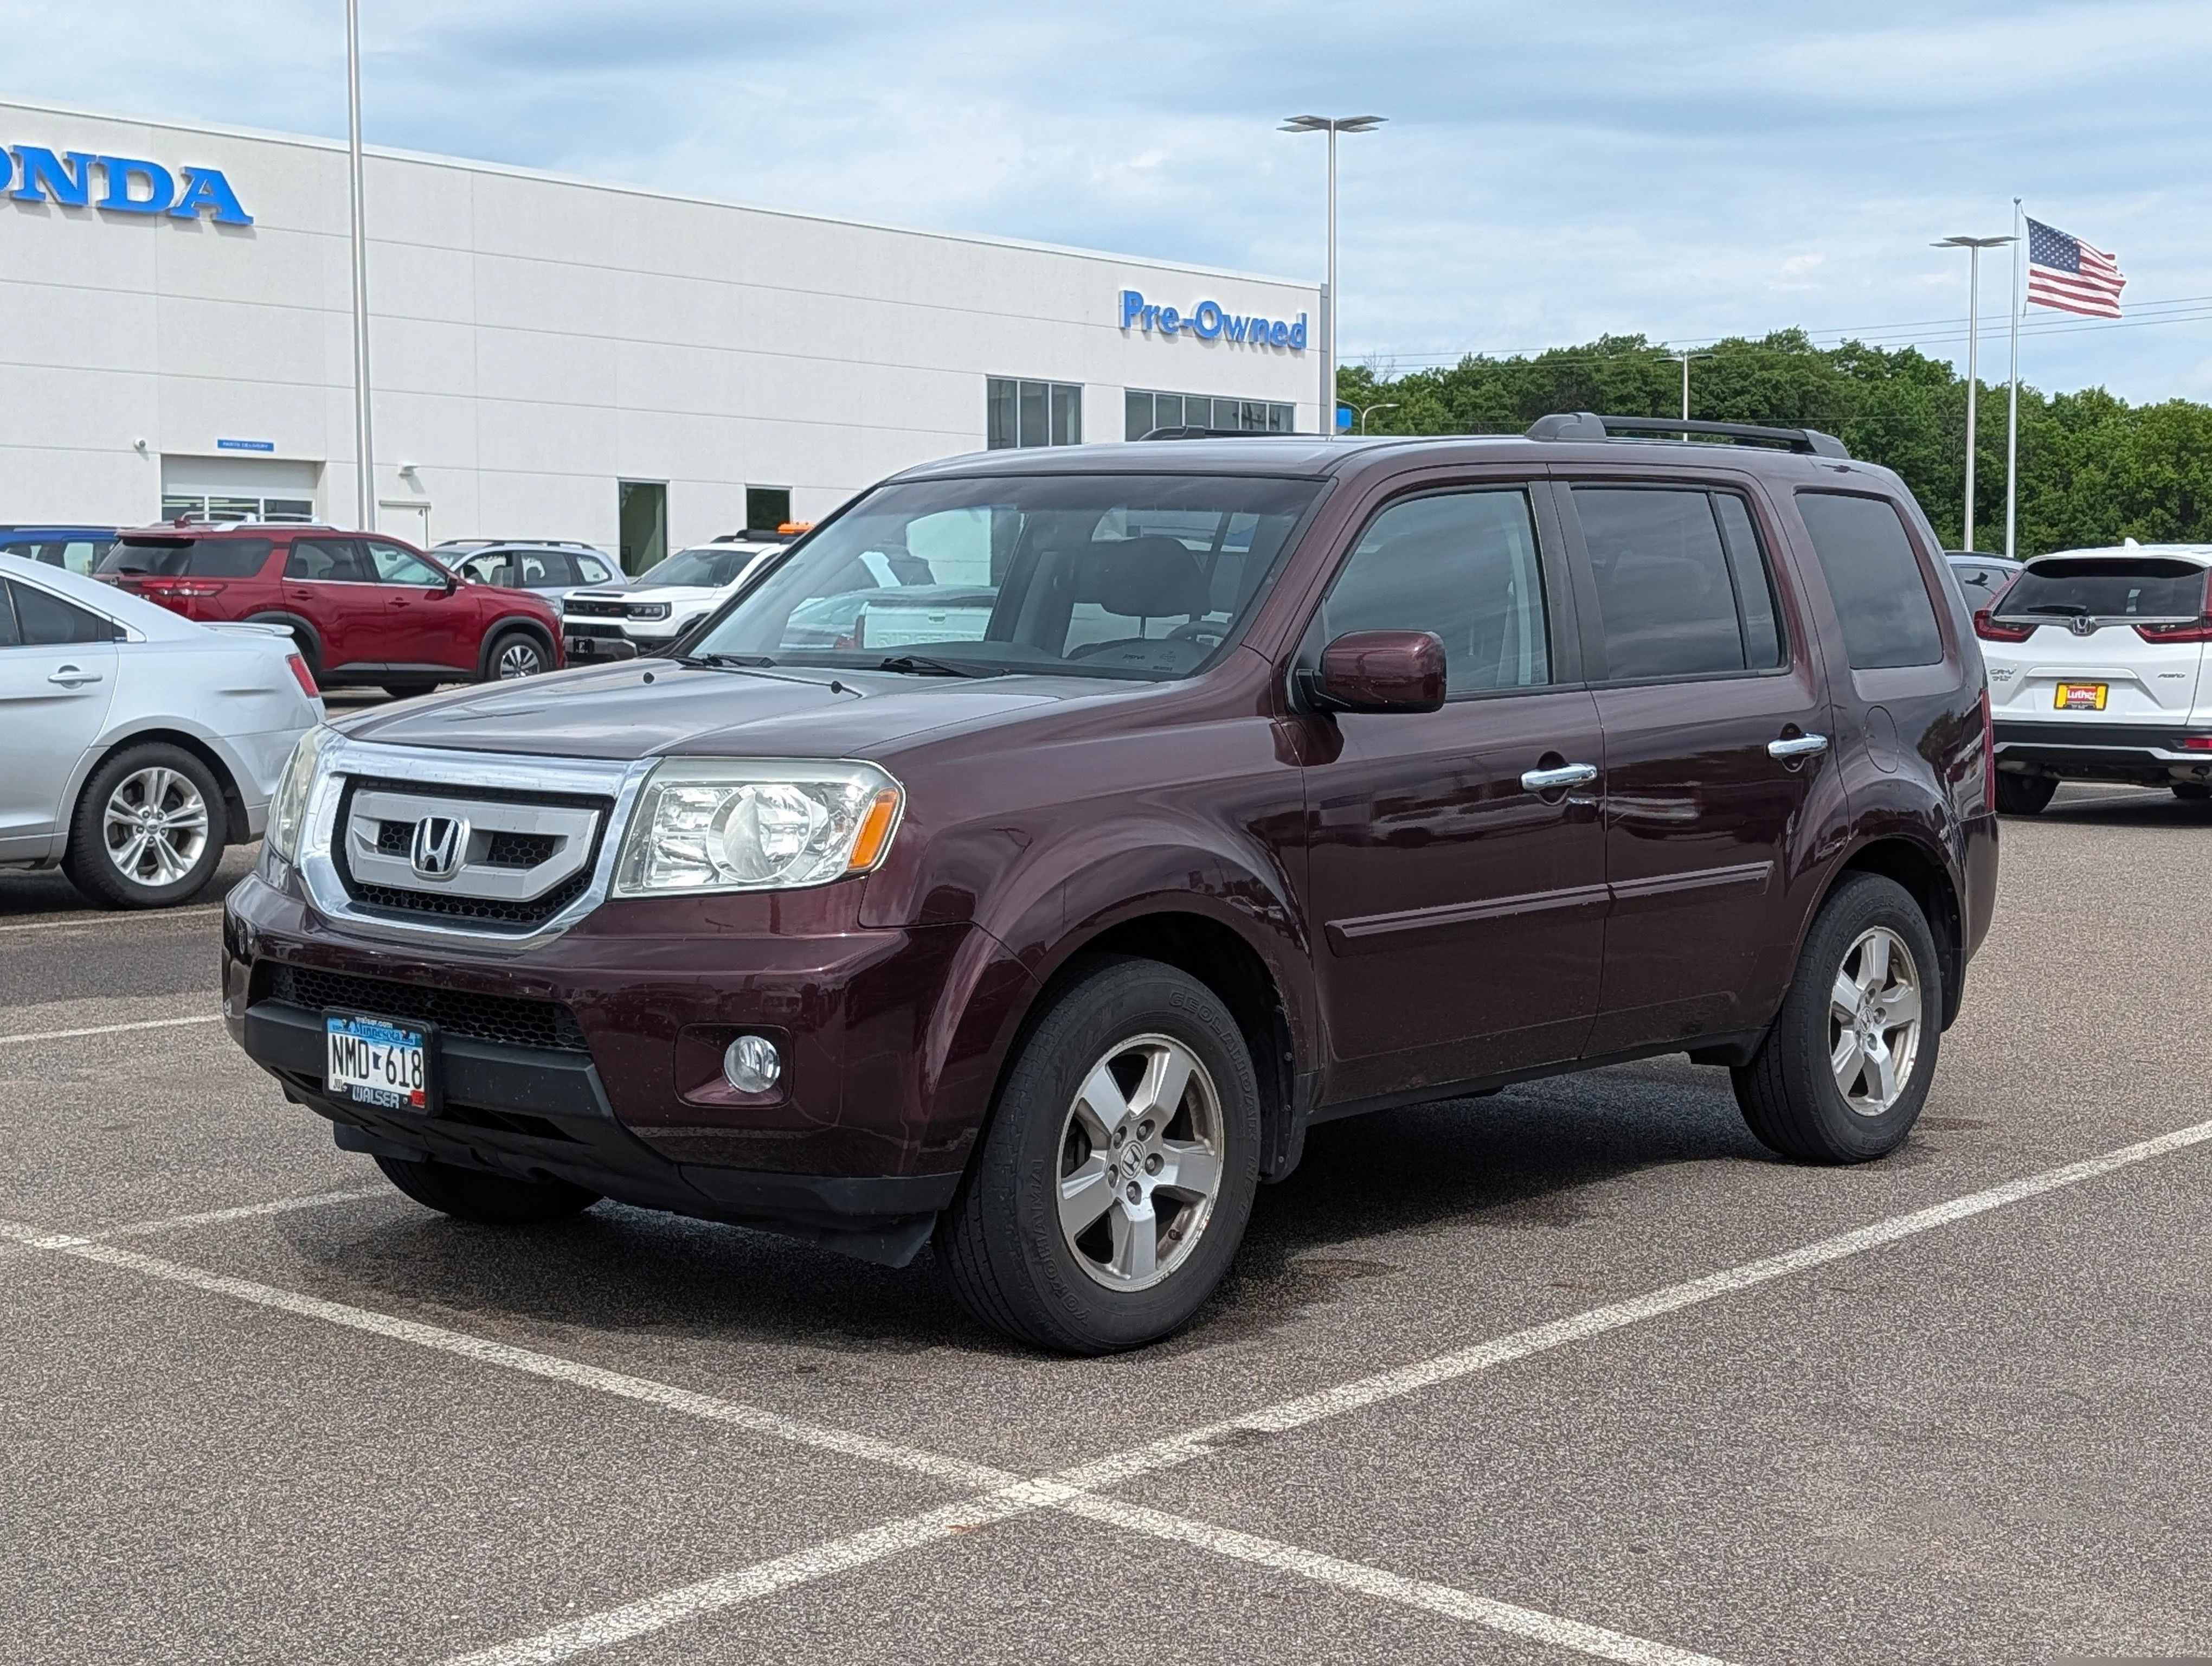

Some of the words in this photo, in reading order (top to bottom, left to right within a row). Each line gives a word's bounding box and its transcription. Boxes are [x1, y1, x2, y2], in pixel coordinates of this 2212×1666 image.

[0, 144, 254, 225] NDA
[1120, 290, 1307, 349] Pre-Owned
[2067, 689, 2097, 701] Luther
[353, 1023, 401, 1041] Minnesota
[332, 1035, 369, 1079] NMD
[386, 1045, 422, 1090] 618
[1169, 989, 1258, 1143] GEOLANDAR
[352, 1085, 399, 1109] WALSER
[1030, 1158, 1091, 1326] YOKOHAMA
